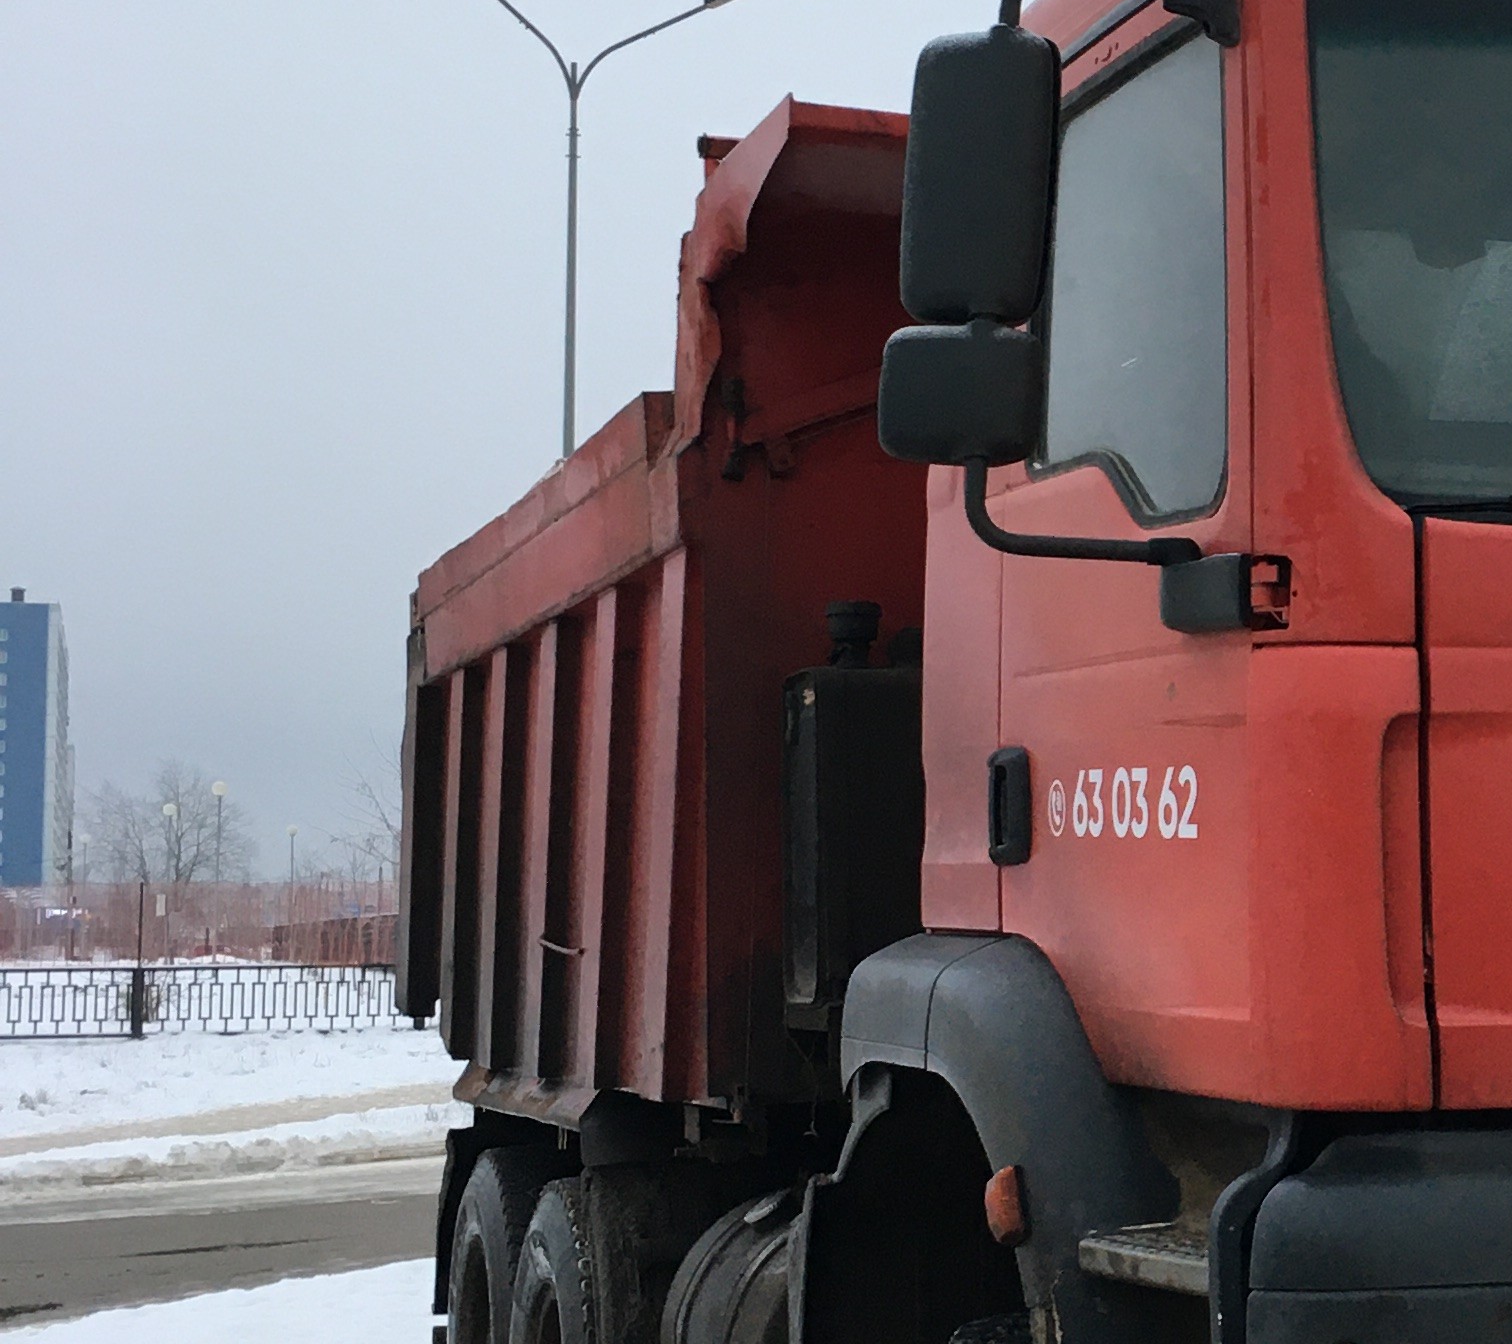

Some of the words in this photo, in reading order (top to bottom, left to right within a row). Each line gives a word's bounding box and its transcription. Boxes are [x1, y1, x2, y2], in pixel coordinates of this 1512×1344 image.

[1073, 769, 1104, 838] 63
[1112, 766, 1149, 838] 03
[1158, 764, 1198, 840] 62
